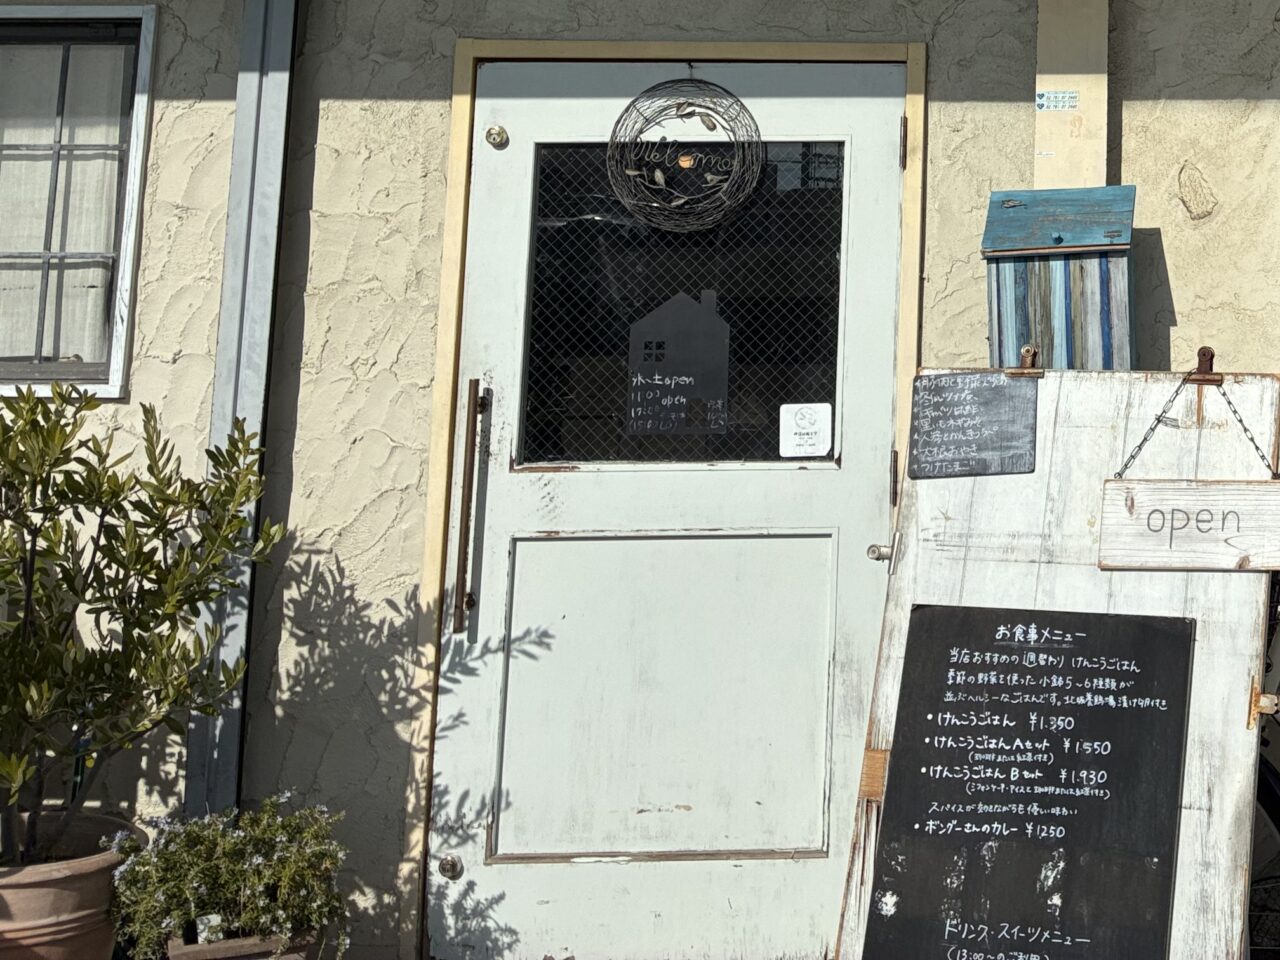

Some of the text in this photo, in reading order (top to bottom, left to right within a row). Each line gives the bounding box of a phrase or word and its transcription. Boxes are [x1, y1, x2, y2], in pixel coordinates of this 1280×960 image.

[1147, 508, 1240, 549] open
[994, 622, 1088, 645] お食事メニュー
[937, 711, 1017, 728] けんこうごはん
